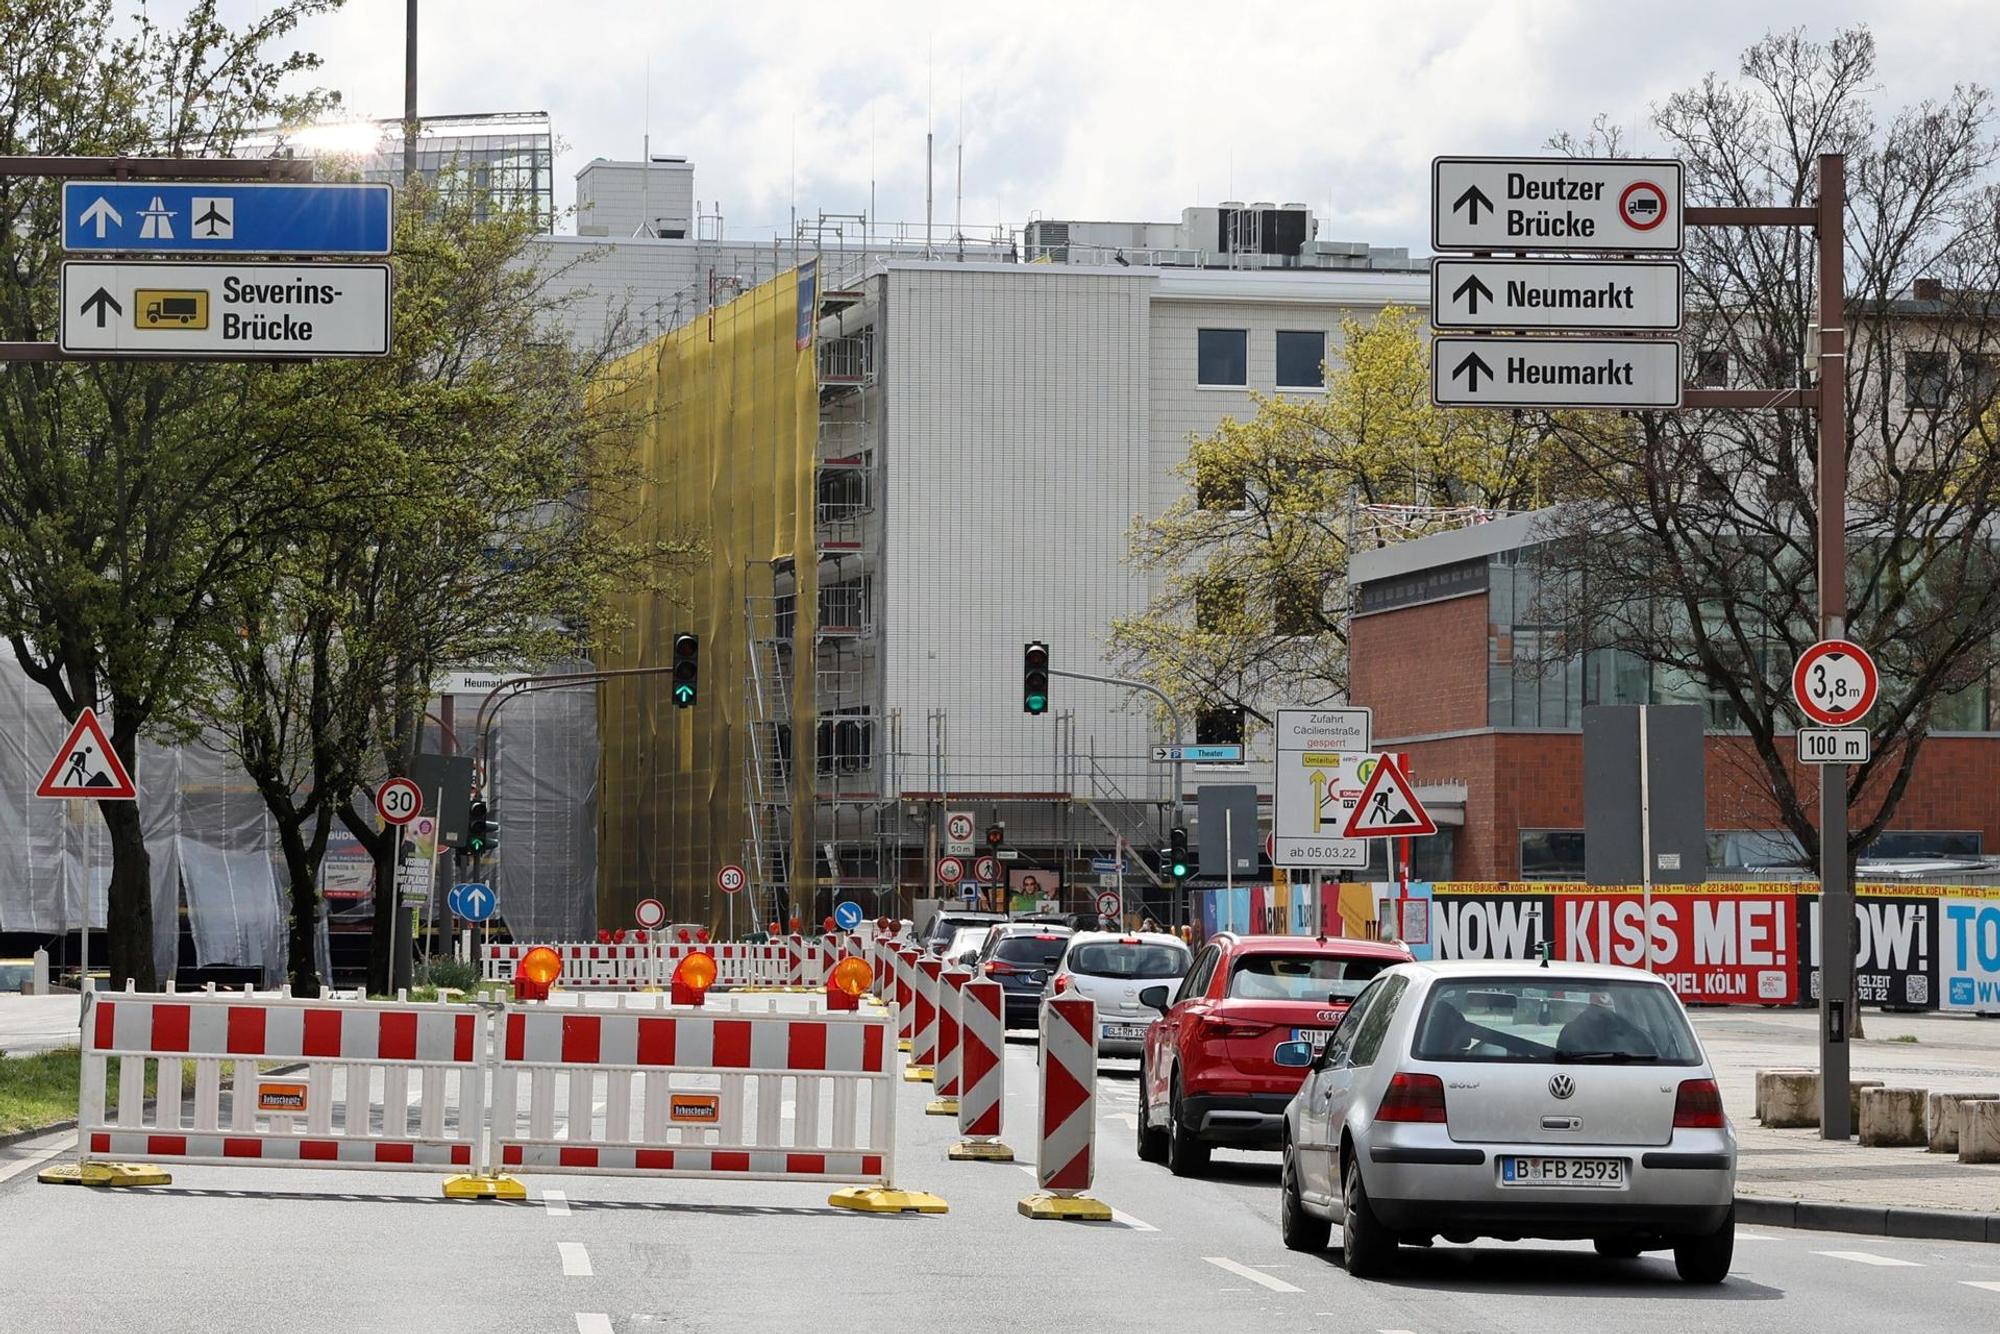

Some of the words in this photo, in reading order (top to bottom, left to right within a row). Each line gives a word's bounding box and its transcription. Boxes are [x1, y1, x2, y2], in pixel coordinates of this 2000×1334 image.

[1507, 173, 1605, 200] Deutzer
[1507, 210, 1595, 237] Brücke
[223, 276, 342, 304] Severins-
[1507, 281, 1634, 308] Neumarkt
[223, 313, 312, 340] Brücke
[1507, 357, 1633, 385] Heumarkt
[1310, 714, 1344, 724] Zufahrt
[1293, 725, 1361, 736] Cäcilienstraße
[1198, 749, 1223, 758] Theater
[1307, 739, 1346, 749] gesperrt
[1808, 736, 1836, 755] 100
[1845, 741, 1859, 755] m
[386, 790, 413, 812] 30
[1290, 848, 1304, 858] ab
[1307, 847, 1357, 858] 05.03.22
[724, 873, 739, 885] 30
[1433, 902, 1543, 960] NOW!
[1566, 900, 1678, 966] KISS
[1693, 901, 1786, 966] ME!
[1705, 968, 1746, 994] KÖLN
[1875, 989, 1888, 1001] 22
[1516, 1160, 1529, 1178] B
[1543, 1160, 1567, 1179] FB
[1572, 1160, 1619, 1180] 2593
